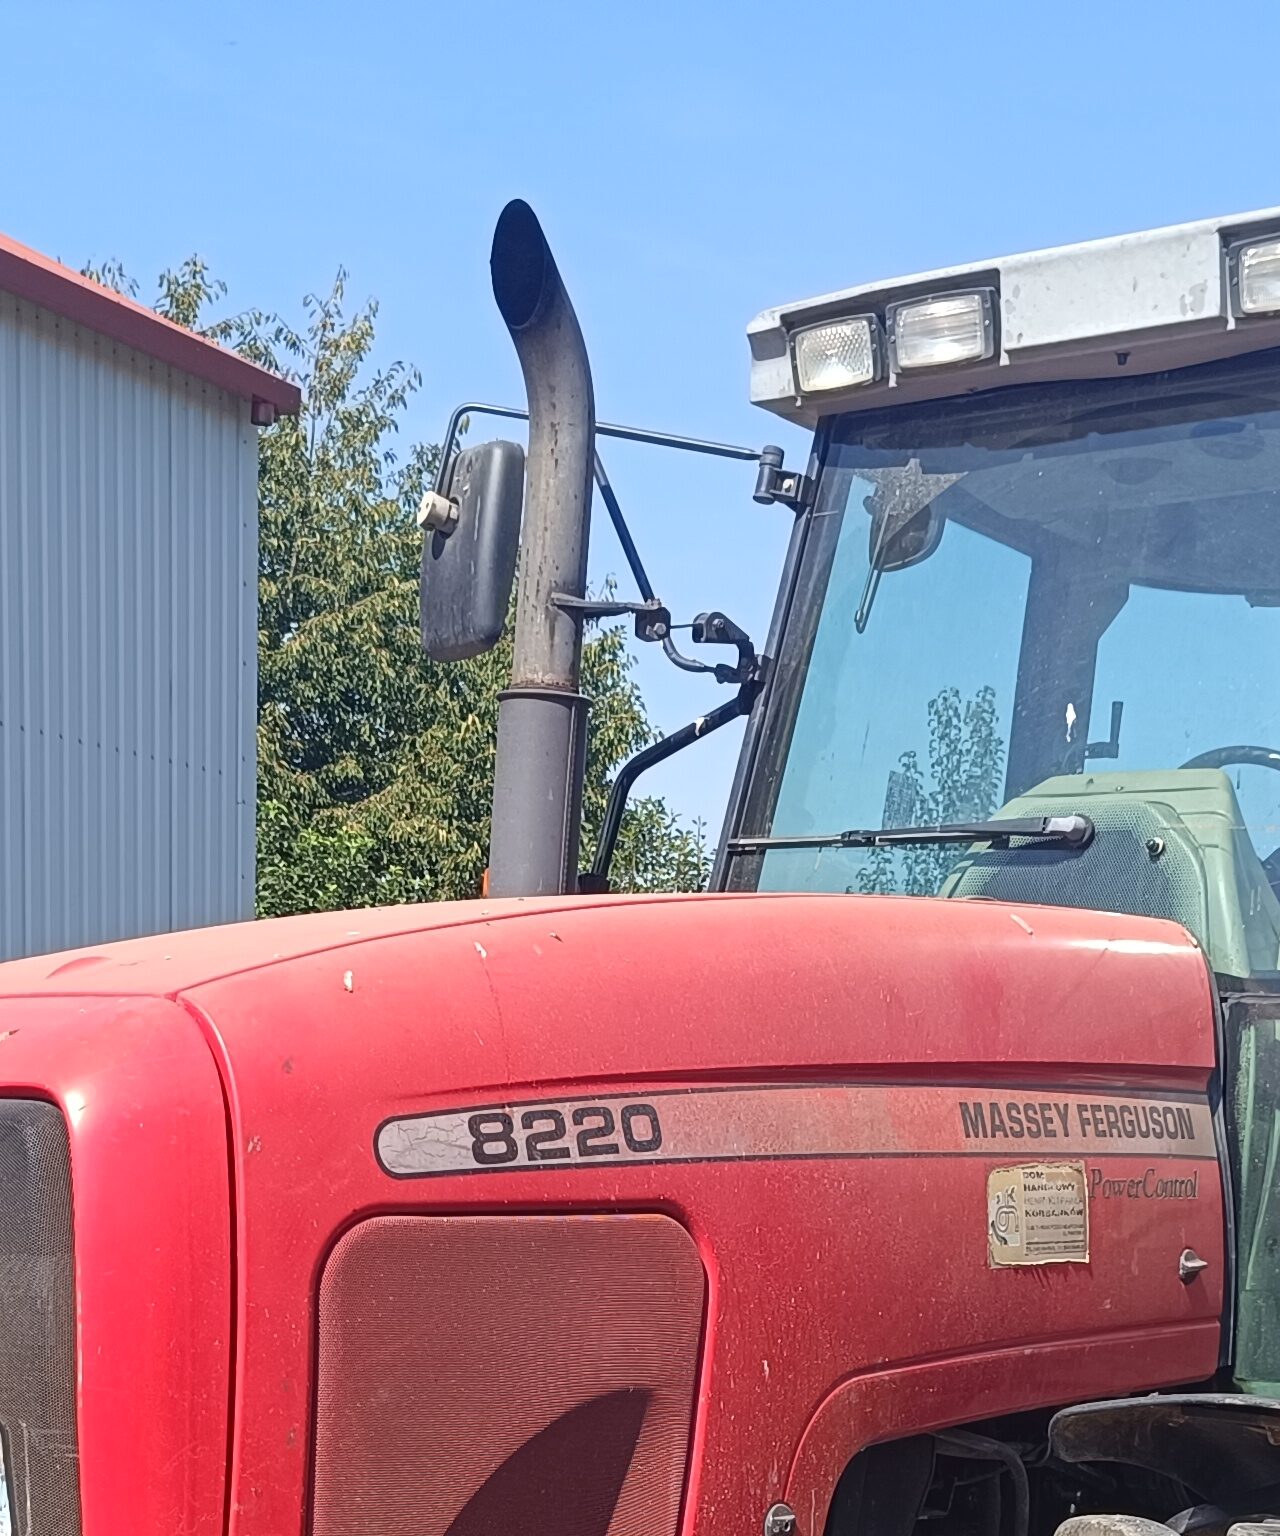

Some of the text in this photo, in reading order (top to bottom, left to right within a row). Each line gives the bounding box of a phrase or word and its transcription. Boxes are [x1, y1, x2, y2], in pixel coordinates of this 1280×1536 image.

[468, 1103, 662, 1165] 8220
[958, 1101, 1195, 1140] MASSEY FERGUSON
[1088, 1168, 1198, 1199] PowerControl
